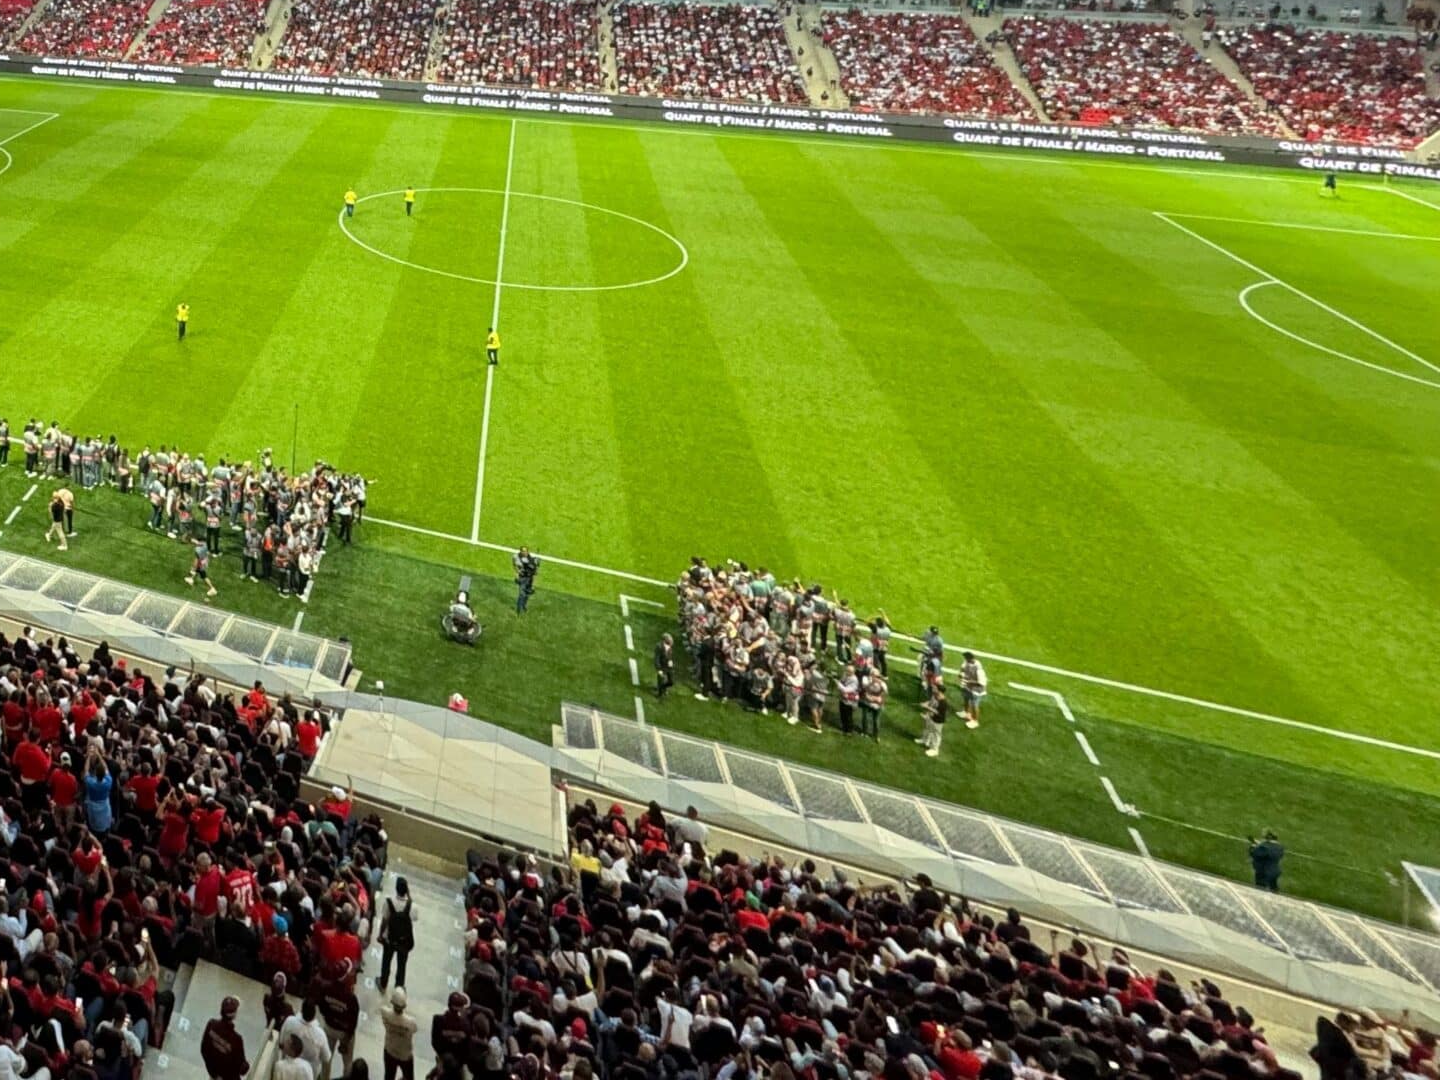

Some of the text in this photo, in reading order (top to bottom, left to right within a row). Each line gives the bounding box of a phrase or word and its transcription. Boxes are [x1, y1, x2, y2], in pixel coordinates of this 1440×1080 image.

[426, 84, 458, 92] QUART
[474, 86, 509, 96] FINALE
[559, 92, 612, 103] PORTUGAL
[422, 94, 613, 116] QUART DE FINALE MAROC PORTUGAL
[662, 99, 699, 109] QUART
[719, 103, 760, 113] FINALE
[769, 107, 810, 117] MAROC
[820, 110, 884, 122] PORTUGAL
[663, 111, 704, 122] QUART
[705, 116, 720, 124] DE
[723, 115, 765, 127] FINALE
[774, 119, 817, 130] MAROC
[827, 123, 892, 136] PORTUGAL
[943, 119, 988, 129] QUART
[1011, 123, 1060, 134] FINALE
[1131, 131, 1207, 144] PORTUGAL
[953, 132, 1000, 144] QUART
[1002, 137, 1021, 146] DE
[1023, 137, 1073, 150] FINALE
[1085, 141, 1135, 154] MAROC
[1147, 146, 1225, 161] PORTUGAL
[1337, 146, 1359, 155] DE
[1298, 157, 1357, 171] QUART
[1359, 163, 1382, 173] DE
